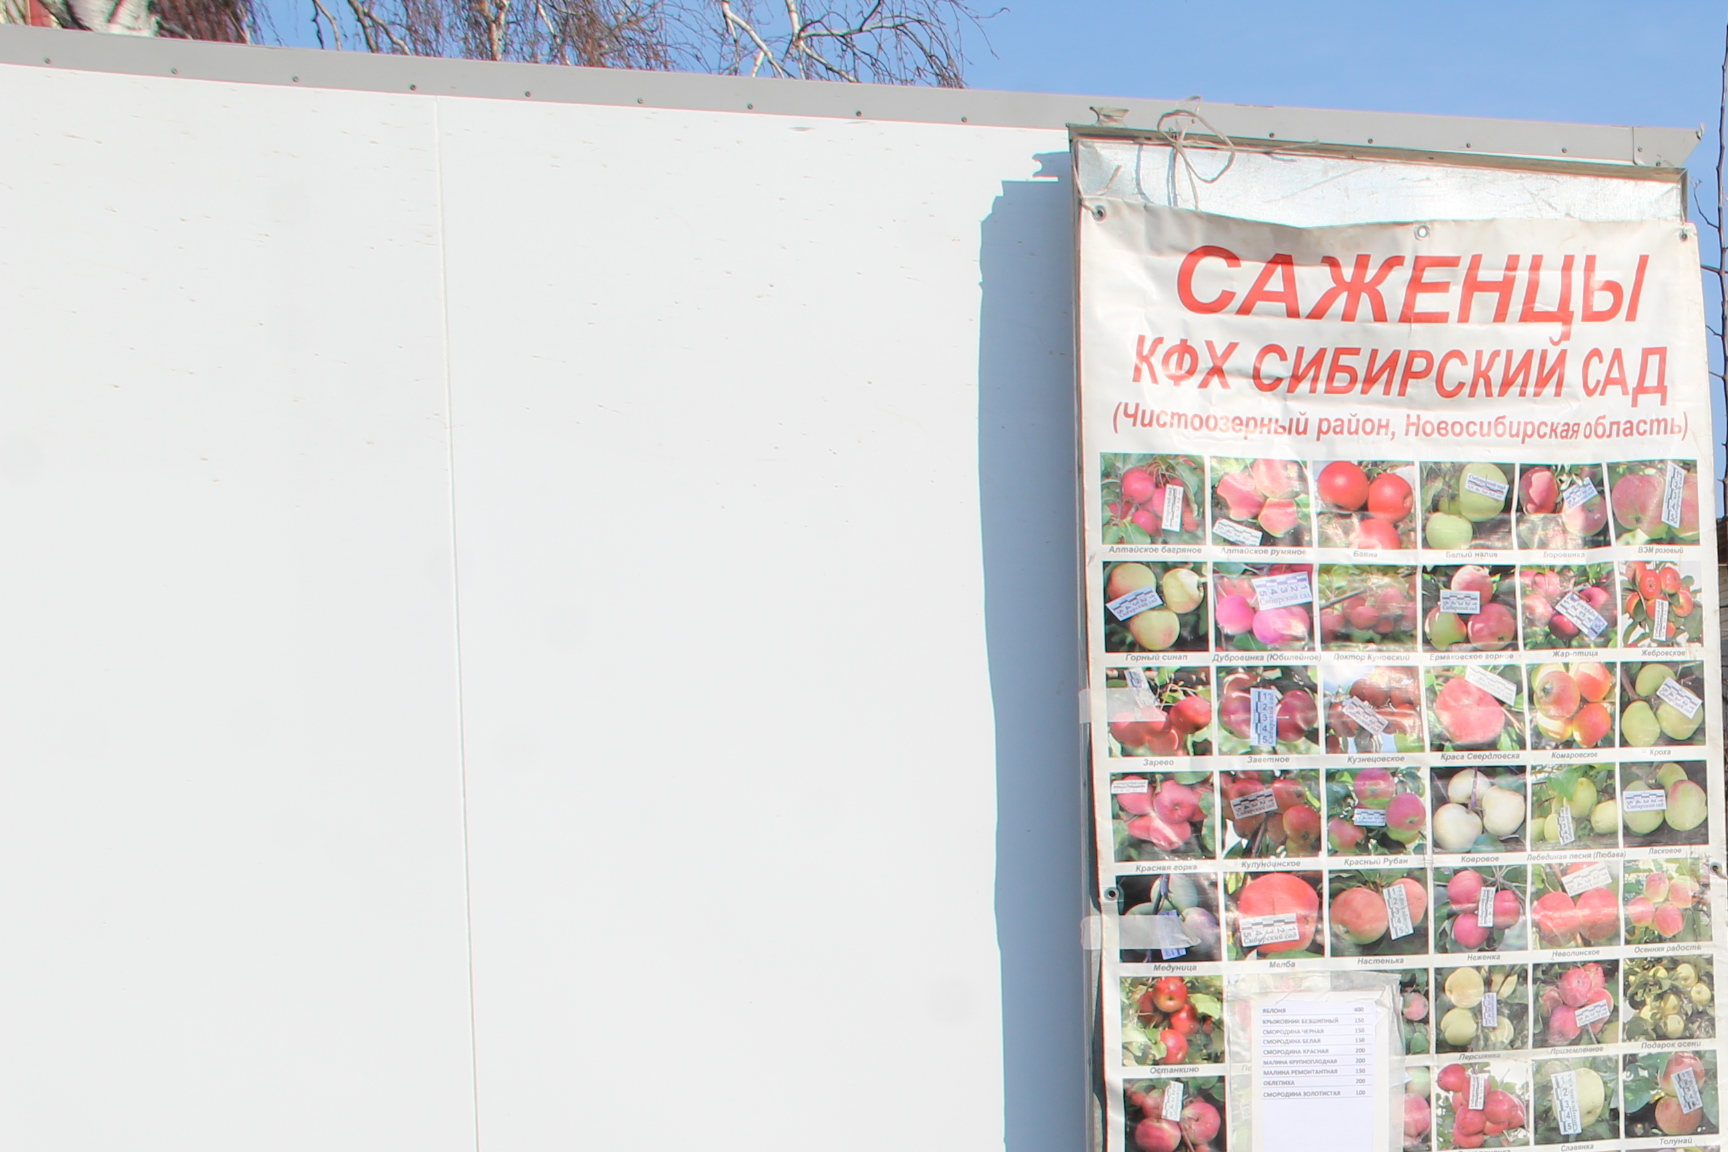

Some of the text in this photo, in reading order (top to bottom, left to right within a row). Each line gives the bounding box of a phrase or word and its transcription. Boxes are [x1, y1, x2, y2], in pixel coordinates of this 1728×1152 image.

[1176, 245, 1651, 341] САЖЕНЦЫ
[1132, 332, 1668, 407] КФХ СИБИРСКИЙ САД
[1112, 400, 1690, 443] (Чистоозерный район, Новосибирская область)
[1109, 546, 1202, 556] Алтайское багряное
[1220, 547, 1307, 557] Алтайское румяное
[1445, 550, 1499, 559] Белый налив
[1543, 550, 1585, 559] Боровинка
[1655, 546, 1684, 556] розовый
[1125, 653, 1188, 663] Горный синап
[1212, 652, 1322, 664] Дубровинка (Юбилейное)
[1333, 653, 1410, 663] Доктор Куновский
[1429, 652, 1483, 661] Ермаковское
[1552, 649, 1599, 659] Жар-птица
[1641, 649, 1686, 658] Жебровское
[1441, 751, 1520, 761] Краса Свердловска
[1551, 751, 1598, 760] Комаровское
[1649, 748, 1672, 757] Кроха
[1143, 759, 1174, 768] Зарево
[1247, 755, 1290, 764] Заветное
[1347, 755, 1405, 765] Кузнецовское
[1649, 846, 1682, 855] Ласковое
[1461, 855, 1500, 864] Ковровое
[1527, 850, 1627, 862] Лебединая песня (Любава)
[1241, 859, 1301, 869] Кулундинское
[1344, 857, 1409, 867] Красный Рубан
[1135, 864, 1198, 873] Красная горка
[1634, 943, 1702, 954] Осенняя радость
[1467, 953, 1501, 962] Неженка
[1552, 949, 1600, 959] Неволинское
[1269, 960, 1296, 969] Мелба
[1357, 957, 1405, 966] Настенька
[1153, 963, 1197, 973] Медуница
[1641, 1039, 1702, 1050] Подарок осени
[1550, 1045, 1604, 1055] Приземленное
[1459, 1052, 1501, 1062] Персиянка
[1150, 1065, 1200, 1075] Останкино
[1659, 1136, 1693, 1146] Толунай
[1560, 1143, 1594, 1152] Славянка
